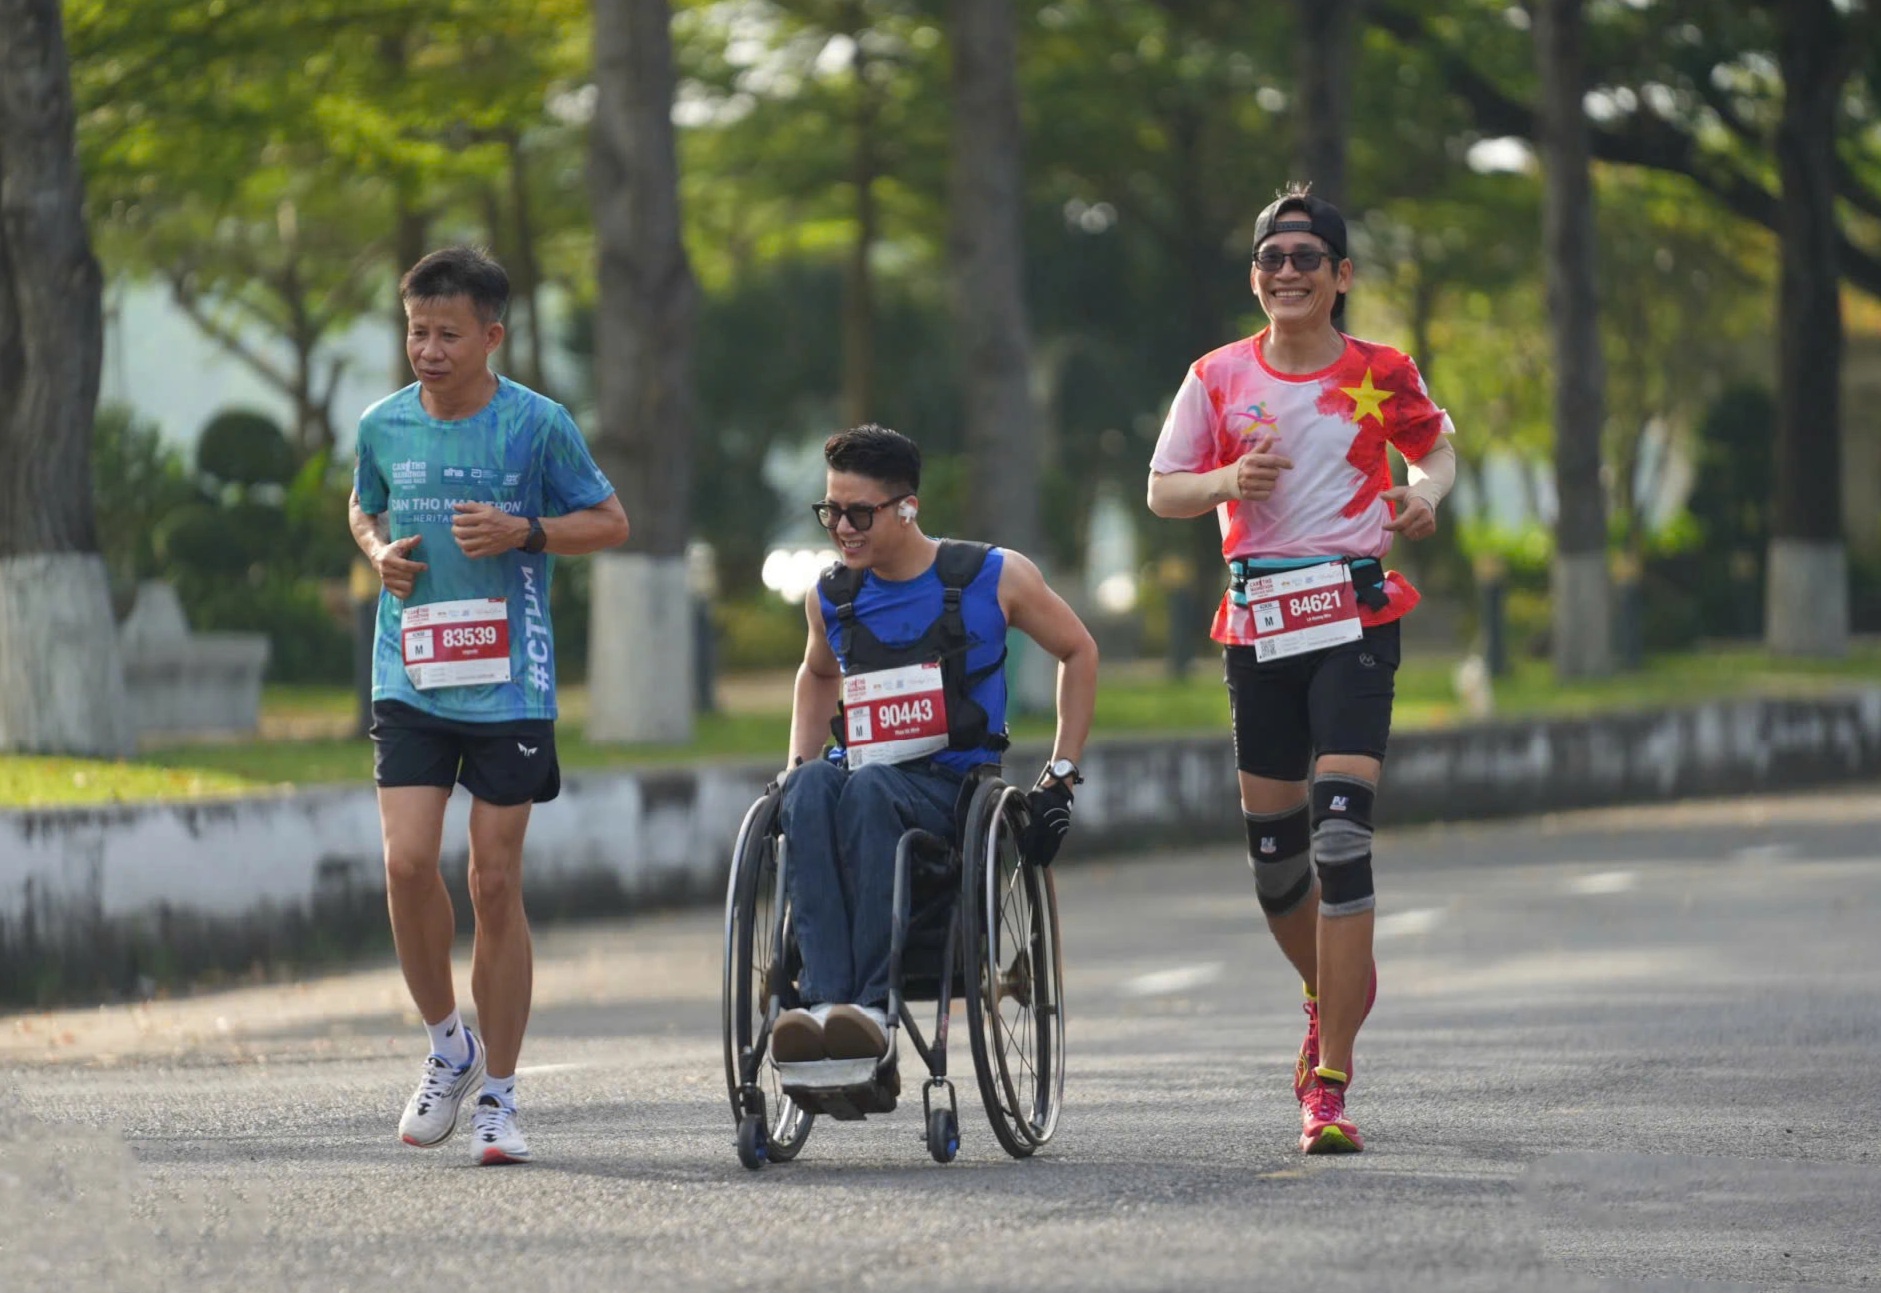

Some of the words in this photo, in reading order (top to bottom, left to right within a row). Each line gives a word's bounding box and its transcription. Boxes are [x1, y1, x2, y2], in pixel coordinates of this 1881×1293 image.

[412, 498, 440, 510] THO
[443, 499, 522, 513] MHON
[413, 514, 454, 523] HERITA
[1289, 590, 1342, 617] 84621
[1264, 616, 1274, 627] M
[442, 626, 497, 648] 83539
[414, 644, 424, 655] M
[879, 698, 933, 729] 90443
[856, 725, 863, 737] M
